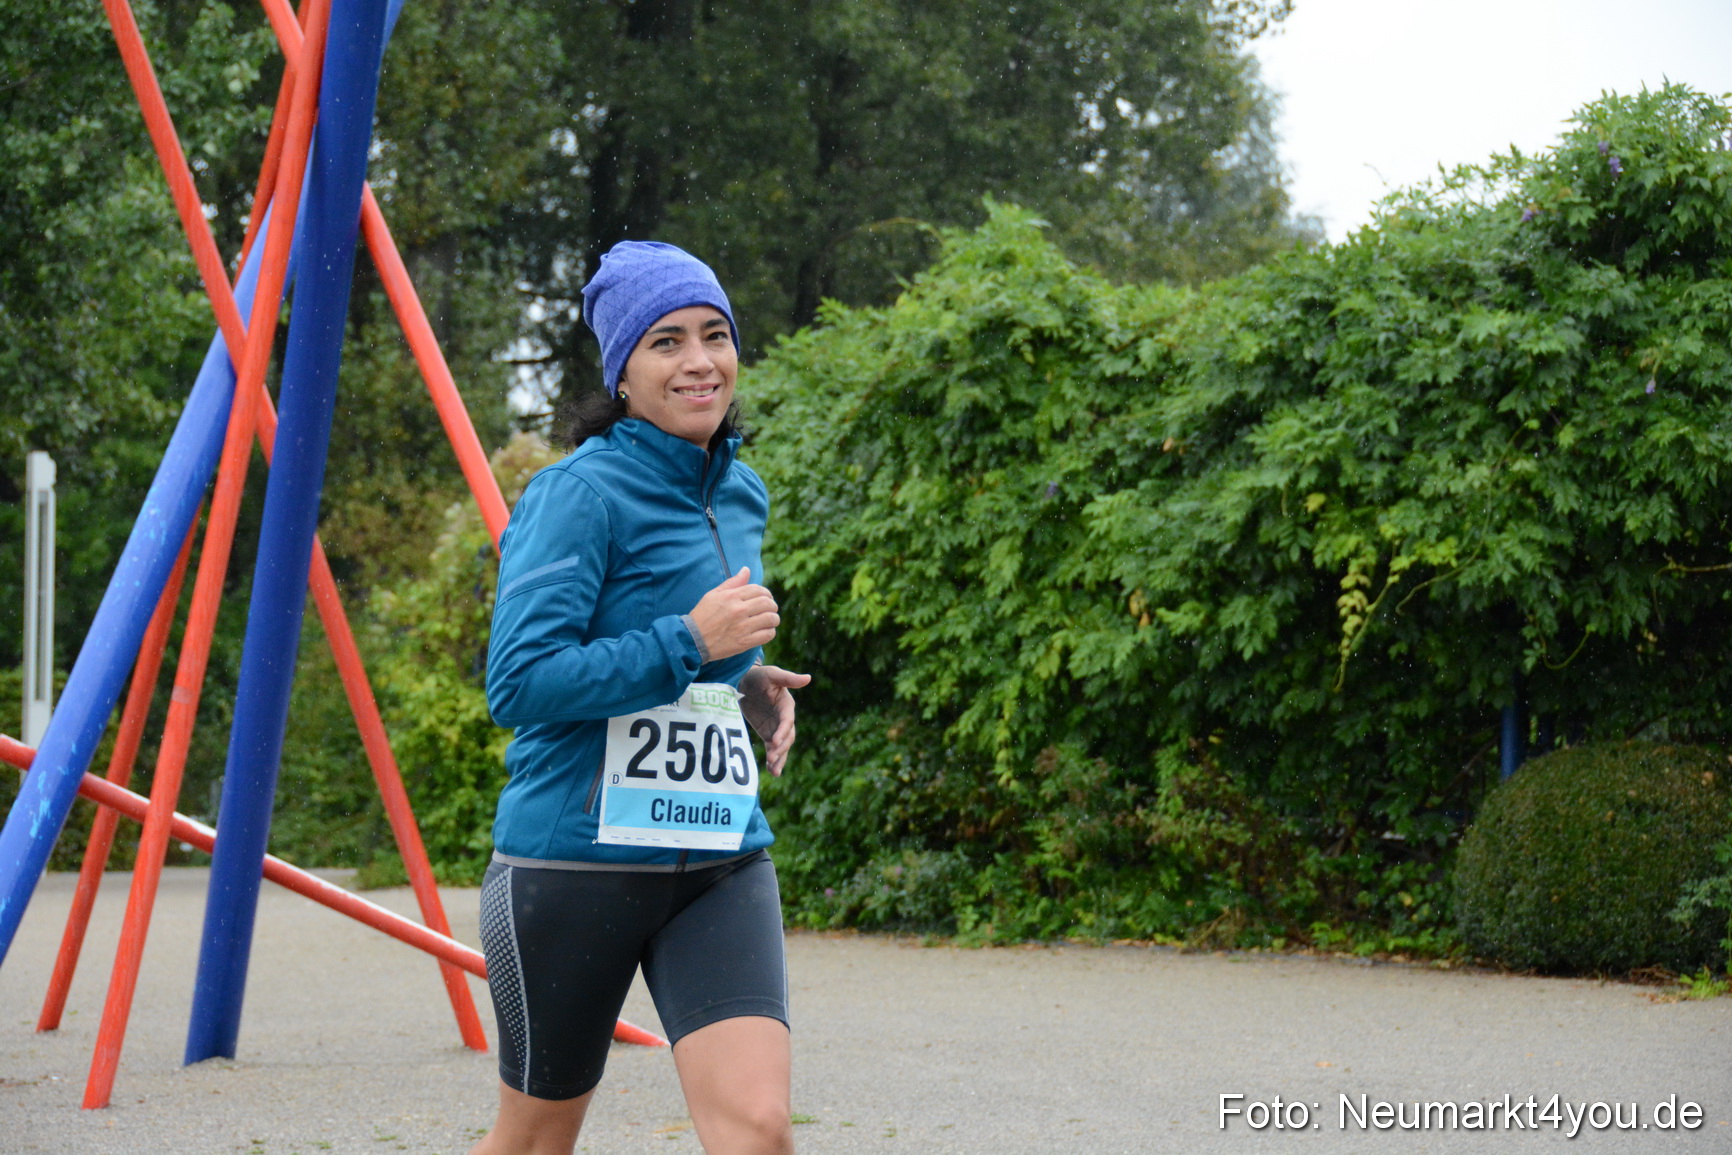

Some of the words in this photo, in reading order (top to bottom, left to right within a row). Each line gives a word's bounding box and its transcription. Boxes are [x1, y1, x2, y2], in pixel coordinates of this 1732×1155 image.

[690, 687, 740, 712] BOCK
[625, 718, 750, 786] 2505
[612, 774, 620, 785] D
[651, 797, 732, 826] Claudia
